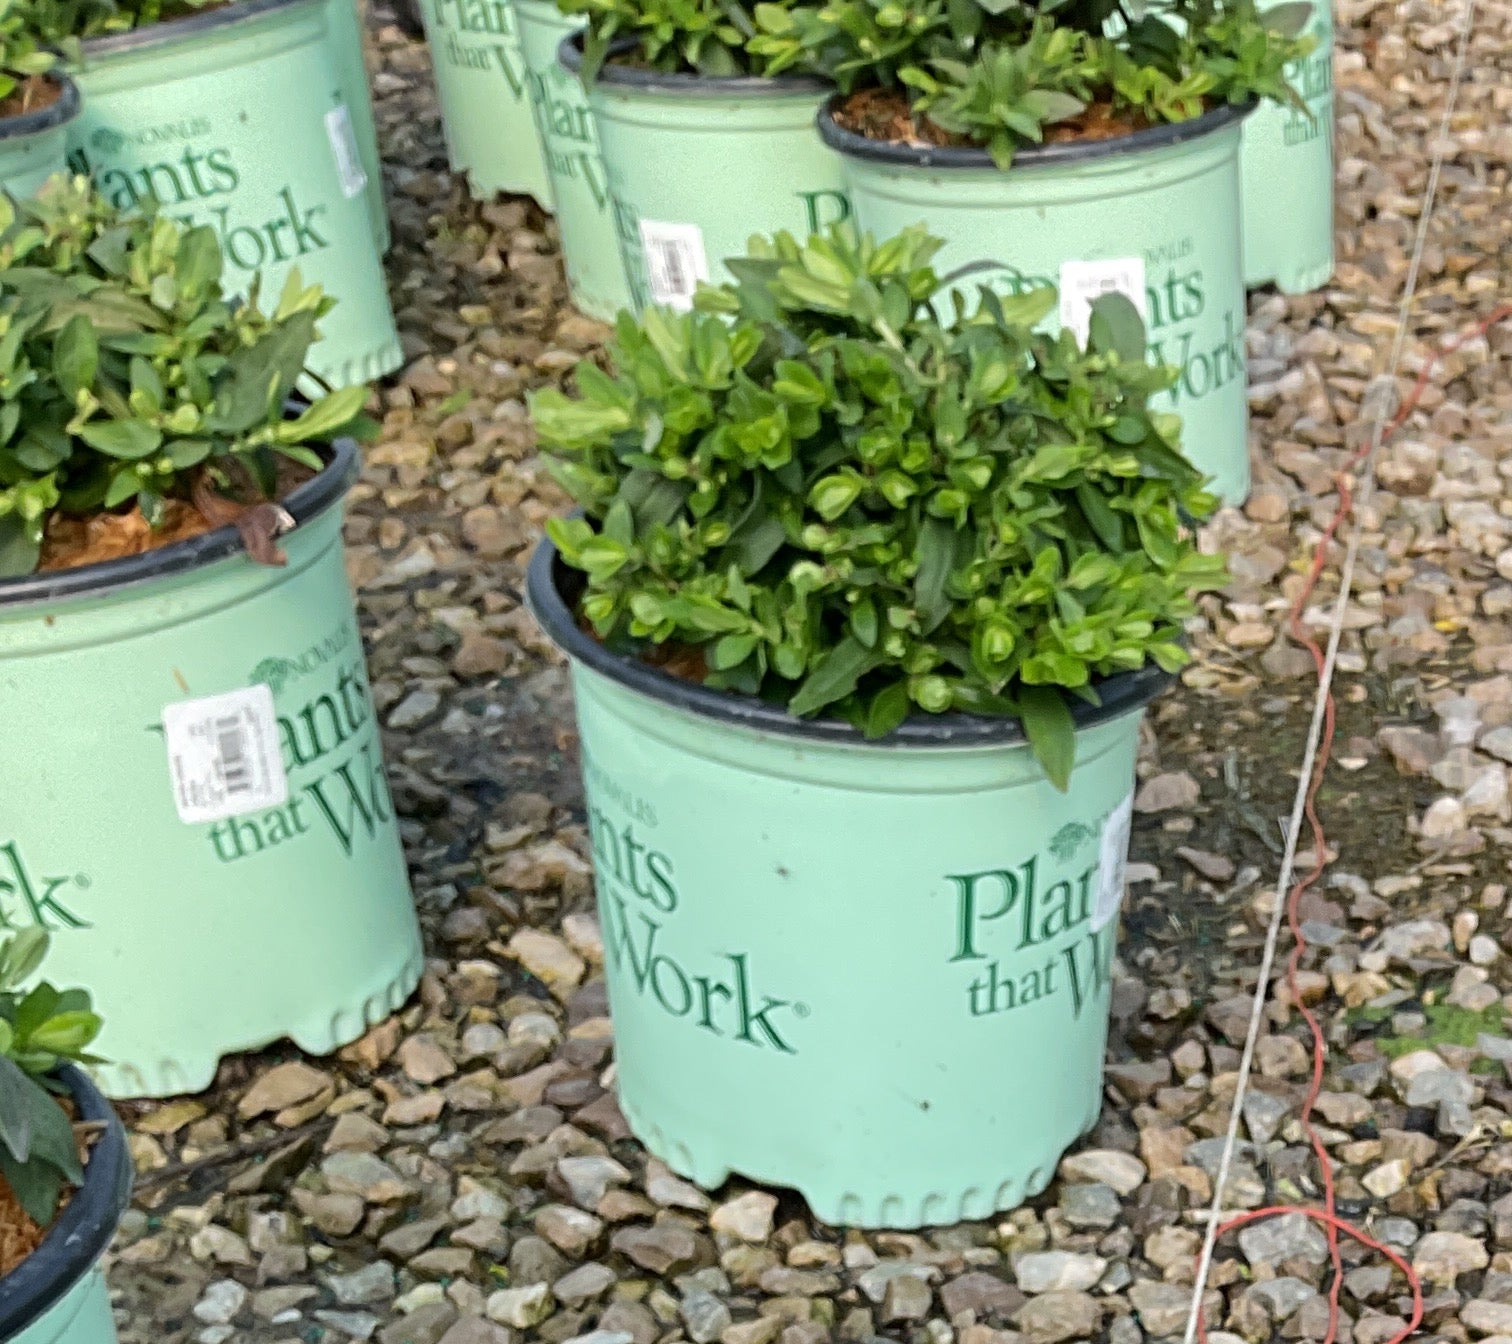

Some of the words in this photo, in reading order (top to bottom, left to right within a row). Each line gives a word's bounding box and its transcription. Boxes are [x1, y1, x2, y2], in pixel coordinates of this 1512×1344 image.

[68, 145, 240, 212] ants
[174, 185, 328, 271] ork
[208, 796, 309, 864] that
[591, 807, 678, 913] nts
[967, 950, 1058, 1018] that
